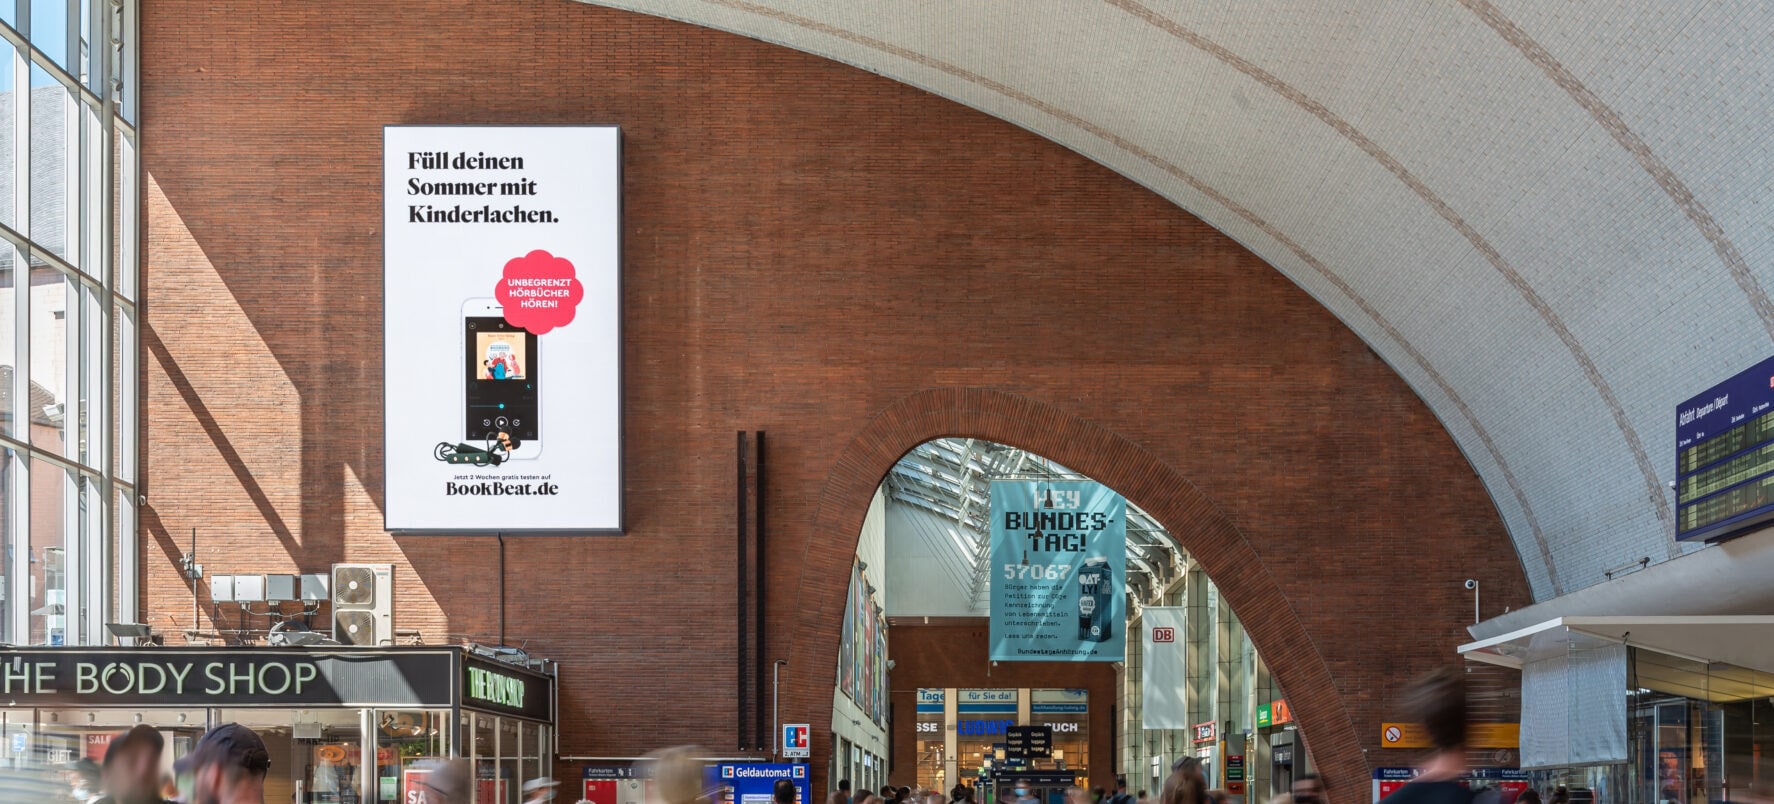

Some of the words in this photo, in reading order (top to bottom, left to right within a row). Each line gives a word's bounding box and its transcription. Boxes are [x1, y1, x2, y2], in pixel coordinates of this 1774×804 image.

[408, 151, 449, 170] Füll
[452, 151, 524, 170] deinen
[407, 177, 498, 196] Sommer
[500, 177, 538, 196] mit
[408, 205, 559, 223] Kinderlachen.
[507, 278, 572, 287] UNBEGRENZT
[509, 287, 570, 297] HÖRBÜCHER
[520, 297, 558, 308] HÖREN!
[1679, 407, 1695, 427] Abfahrt
[446, 481, 559, 496] BookBeat.de
[1033, 490, 1080, 510] HEY
[1005, 511, 1114, 531] BUNDES-
[1028, 534, 1086, 552] TAG!
[1004, 563, 1071, 580] 57067
[1004, 583, 1027, 591] Bürger
[1155, 629, 1172, 641] DB
[0, 660, 57, 694] HE
[76, 662, 194, 695] BODY
[204, 661, 317, 695] SHOP
[468, 666, 487, 699] THE
[486, 670, 506, 705] BODY
[506, 676, 525, 708] SHOP
[969, 692, 981, 700] für
[983, 692, 996, 700] Sie
[998, 692, 1011, 700] da!
[47, 749, 72, 762] GIFT
[736, 767, 791, 778] Geldautomat
